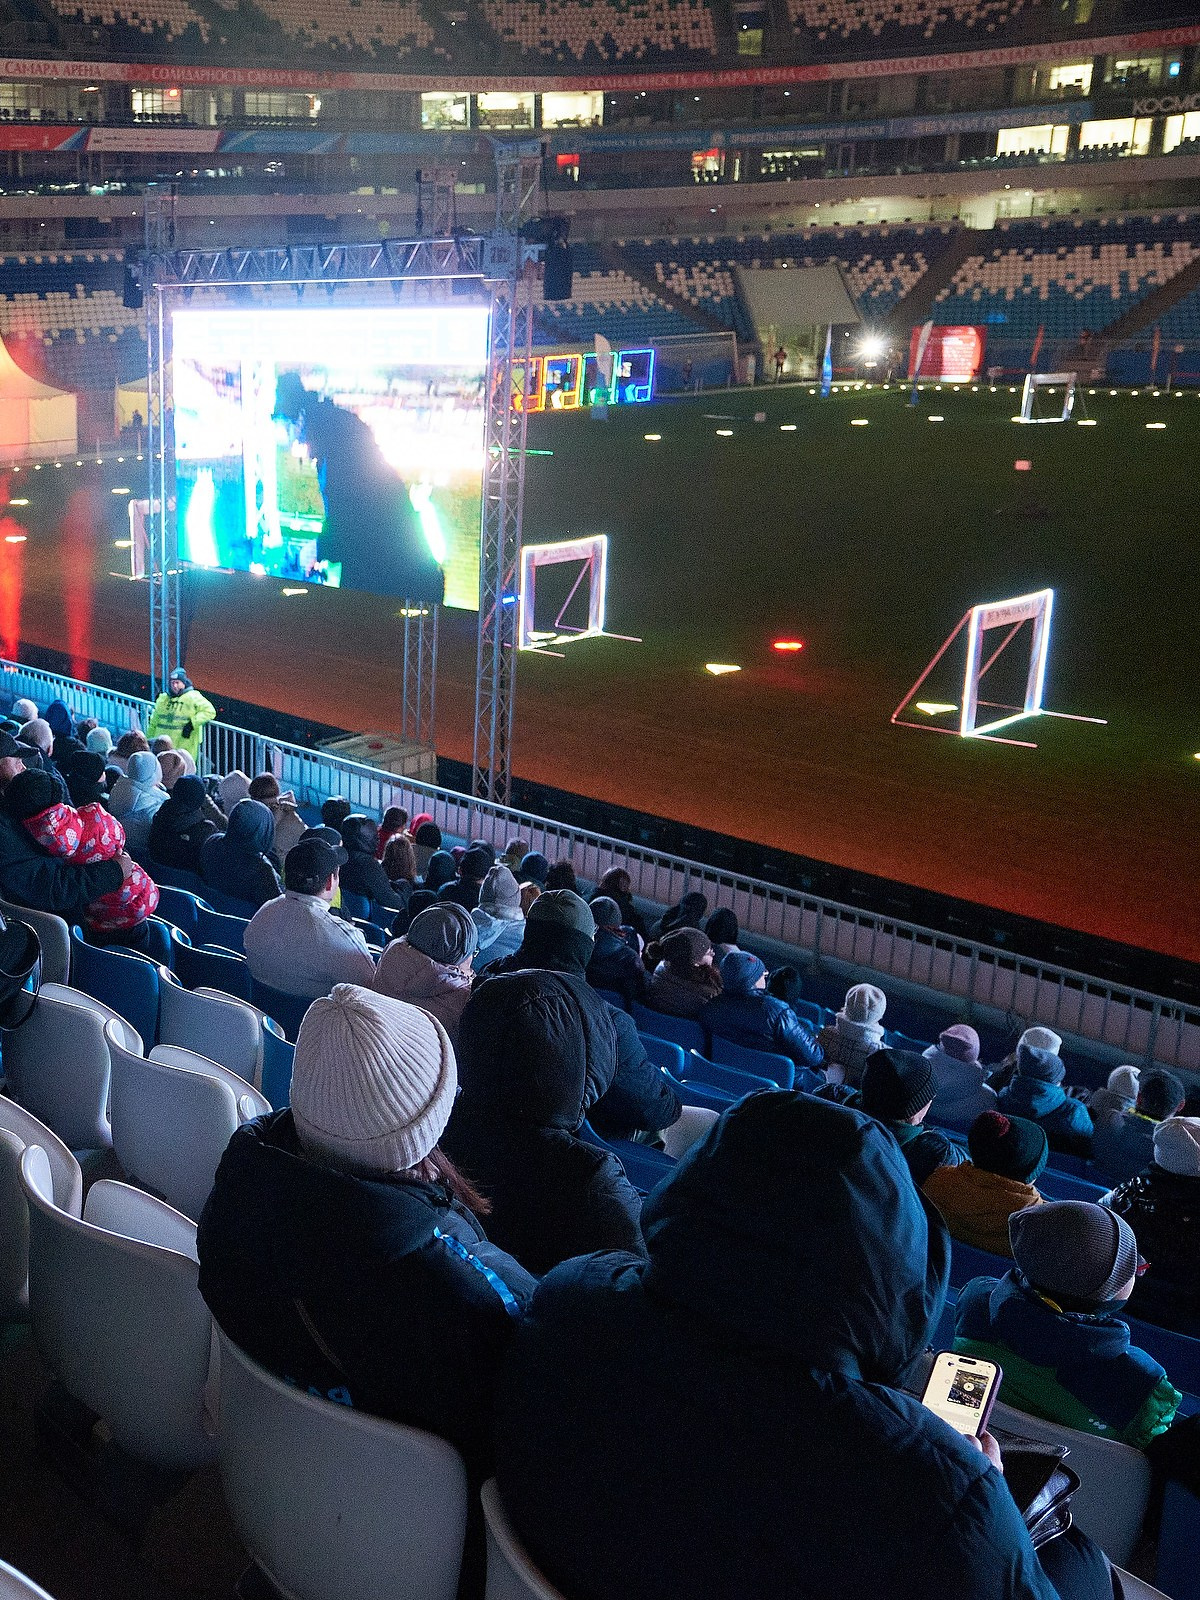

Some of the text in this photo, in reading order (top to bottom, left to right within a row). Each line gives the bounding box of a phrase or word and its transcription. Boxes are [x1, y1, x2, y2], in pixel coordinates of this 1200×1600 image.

[4, 60, 60, 76] САМАРА
[63, 64, 101, 77] АРЕНА
[151, 66, 244, 82] СОЛИДАРНОСТЬ
